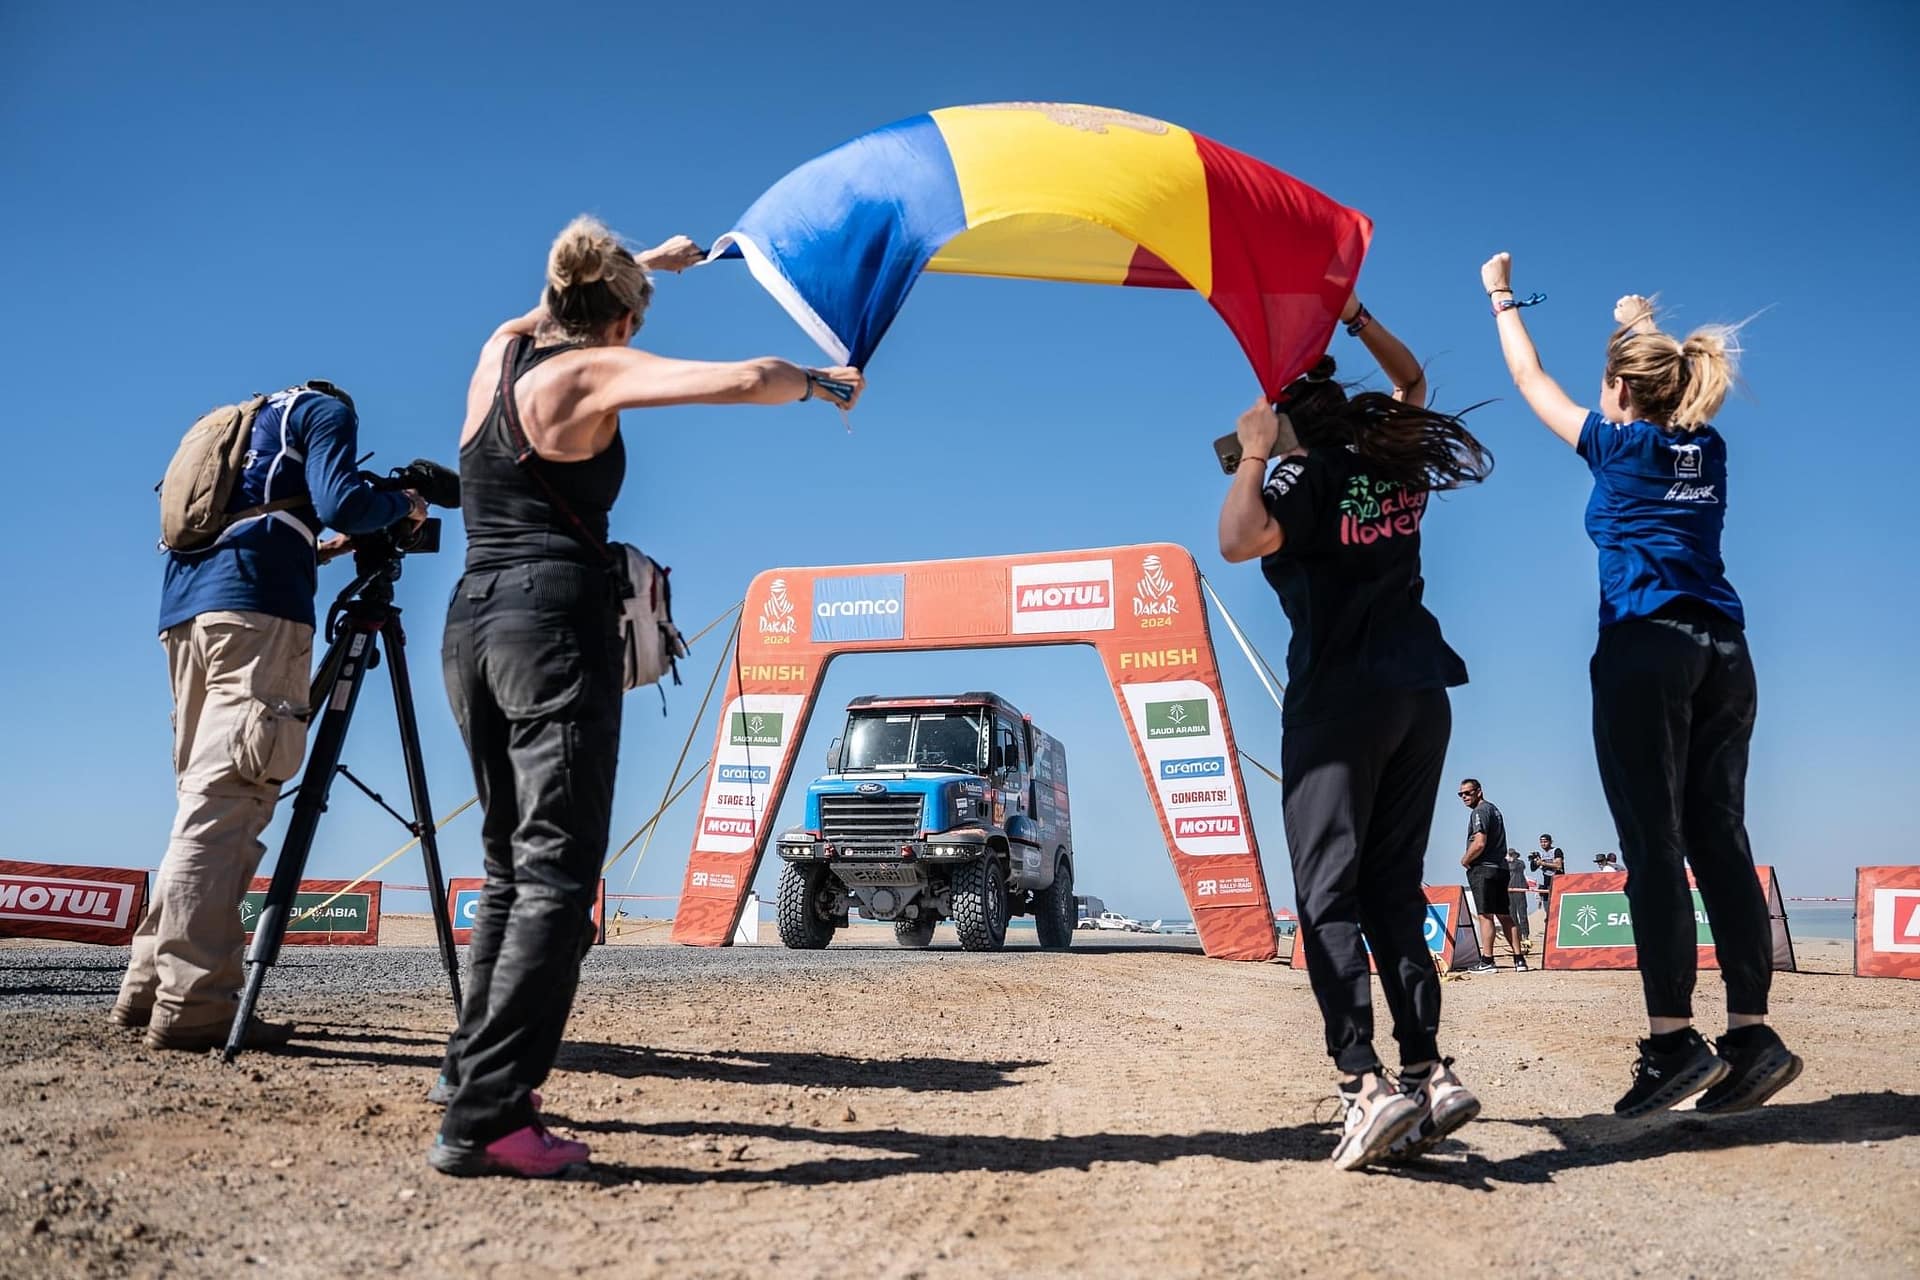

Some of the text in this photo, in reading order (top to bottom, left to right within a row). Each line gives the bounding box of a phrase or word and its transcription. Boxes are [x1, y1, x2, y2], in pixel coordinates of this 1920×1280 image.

[1021, 585, 1105, 608] MOTUL
[817, 600, 899, 617] aramco
[1133, 596, 1179, 616] DAKAR
[759, 615, 797, 634] DAKAR
[1141, 617, 1172, 628] 2024
[763, 635, 790, 644] 2024
[1120, 648, 1197, 669] FINISH
[740, 666, 805, 680] FINISH
[1150, 725, 1207, 736] SAUDI ARABIA
[753, 736, 778, 744] ARABIA
[722, 768, 767, 779] aramco
[1165, 761, 1220, 774] aramco
[718, 794, 756, 807] STAGE 12
[1171, 790, 1227, 804] CONGRATS!
[707, 821, 752, 834] MOTUL
[1180, 819, 1236, 833] MOTUL
